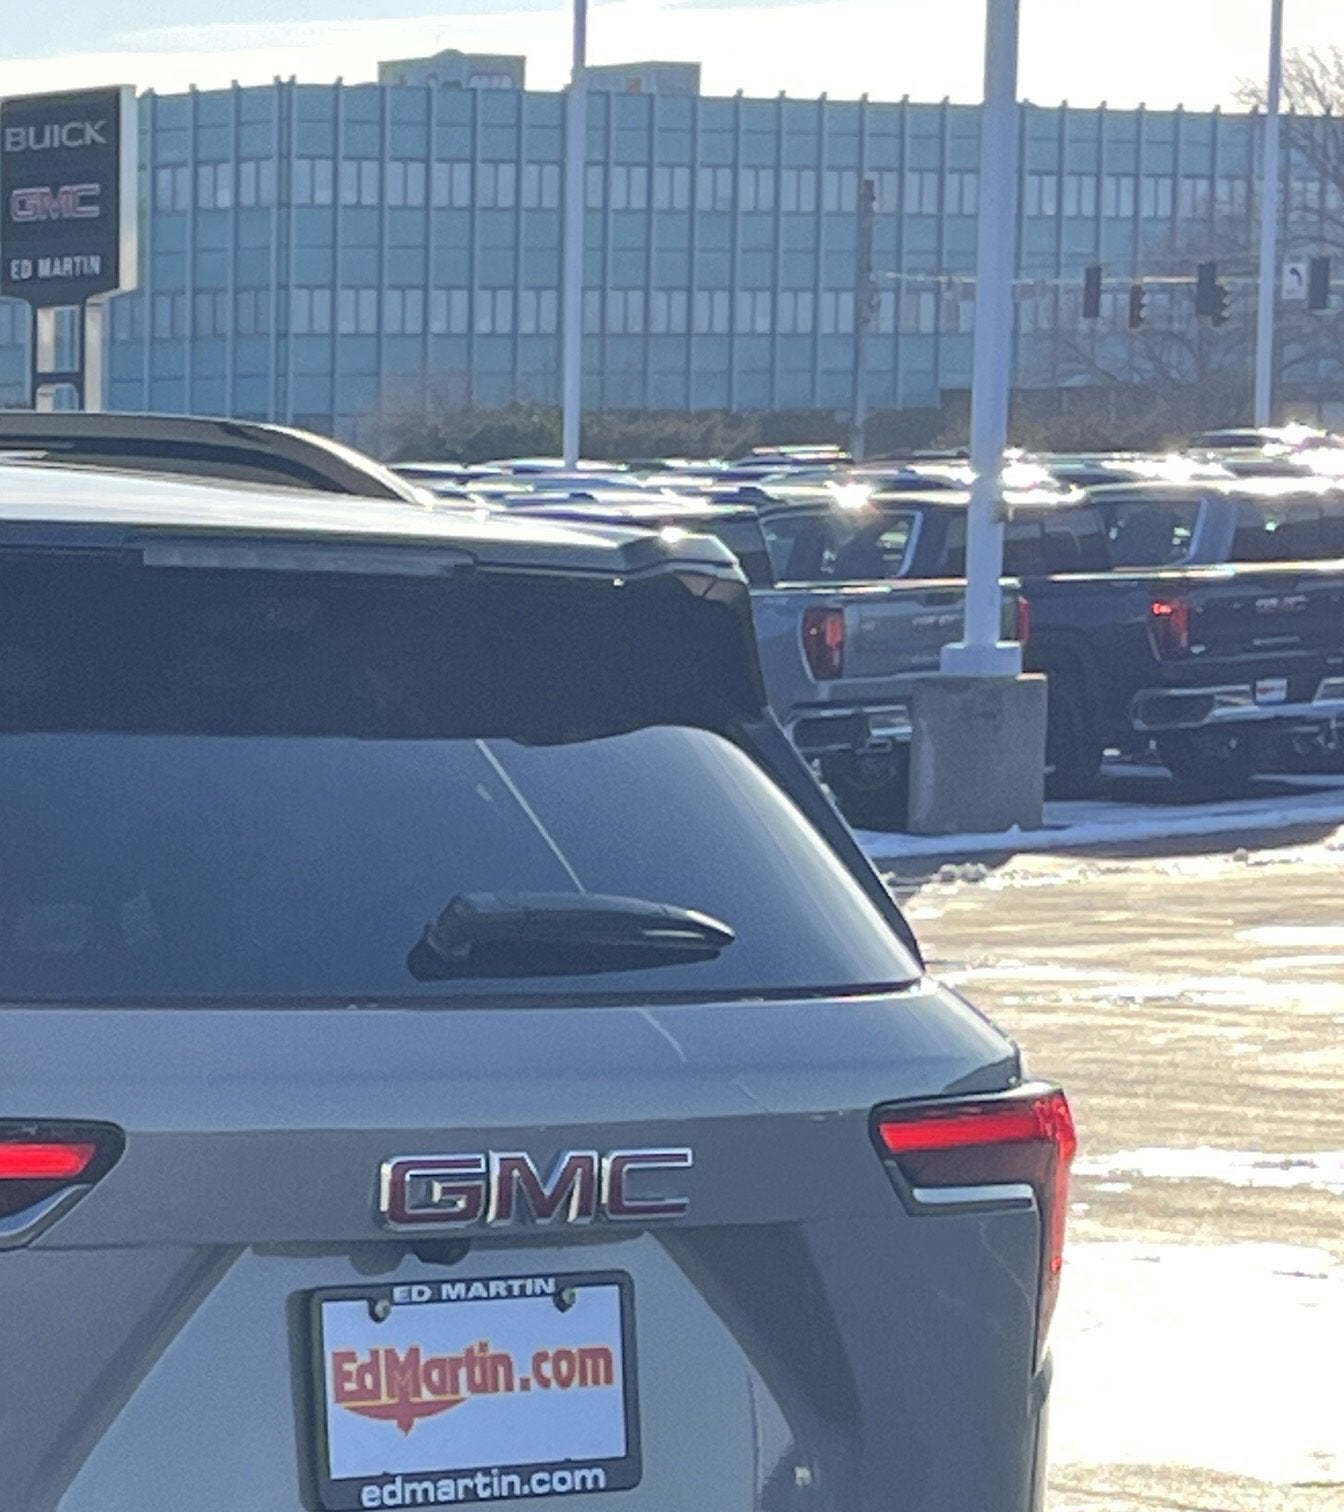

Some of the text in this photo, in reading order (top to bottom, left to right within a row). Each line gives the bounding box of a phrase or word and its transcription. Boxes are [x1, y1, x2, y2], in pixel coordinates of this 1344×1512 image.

[5, 121, 107, 151] BUICK
[11, 184, 100, 221] GMC
[11, 255, 100, 279] ED MARTIN
[376, 1148, 694, 1232] GMC
[393, 1277, 556, 1303] ED MARTIN
[331, 1340, 613, 1404] EdMartin.com
[361, 1465, 606, 1510] edmartin.com
